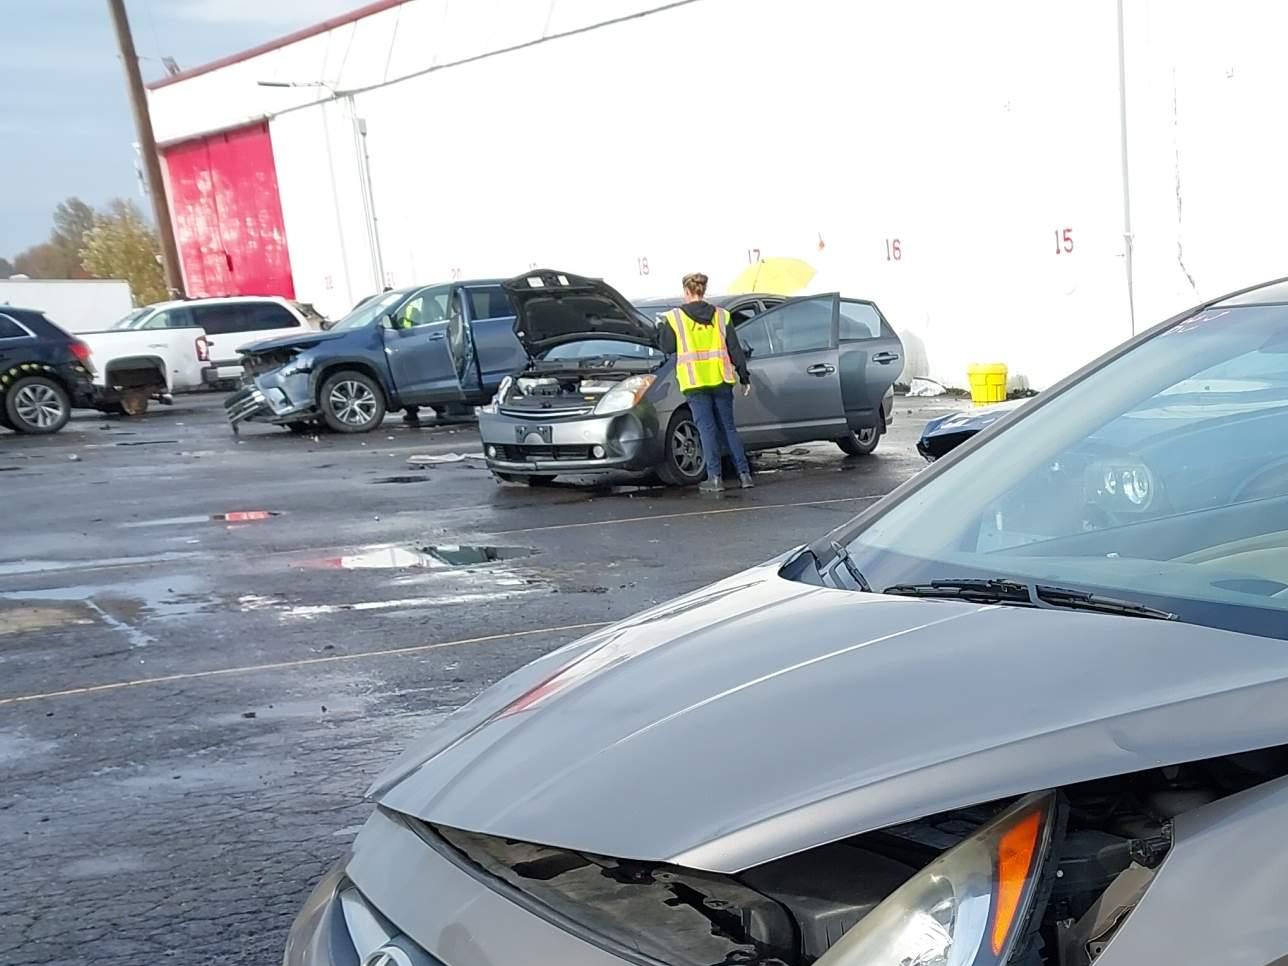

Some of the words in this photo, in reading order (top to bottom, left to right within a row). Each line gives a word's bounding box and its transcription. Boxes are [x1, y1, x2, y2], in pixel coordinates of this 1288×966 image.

[885, 239, 902, 261] 16
[1055, 228, 1074, 255] 15
[637, 256, 650, 276] 18
[747, 248, 762, 265] 17
